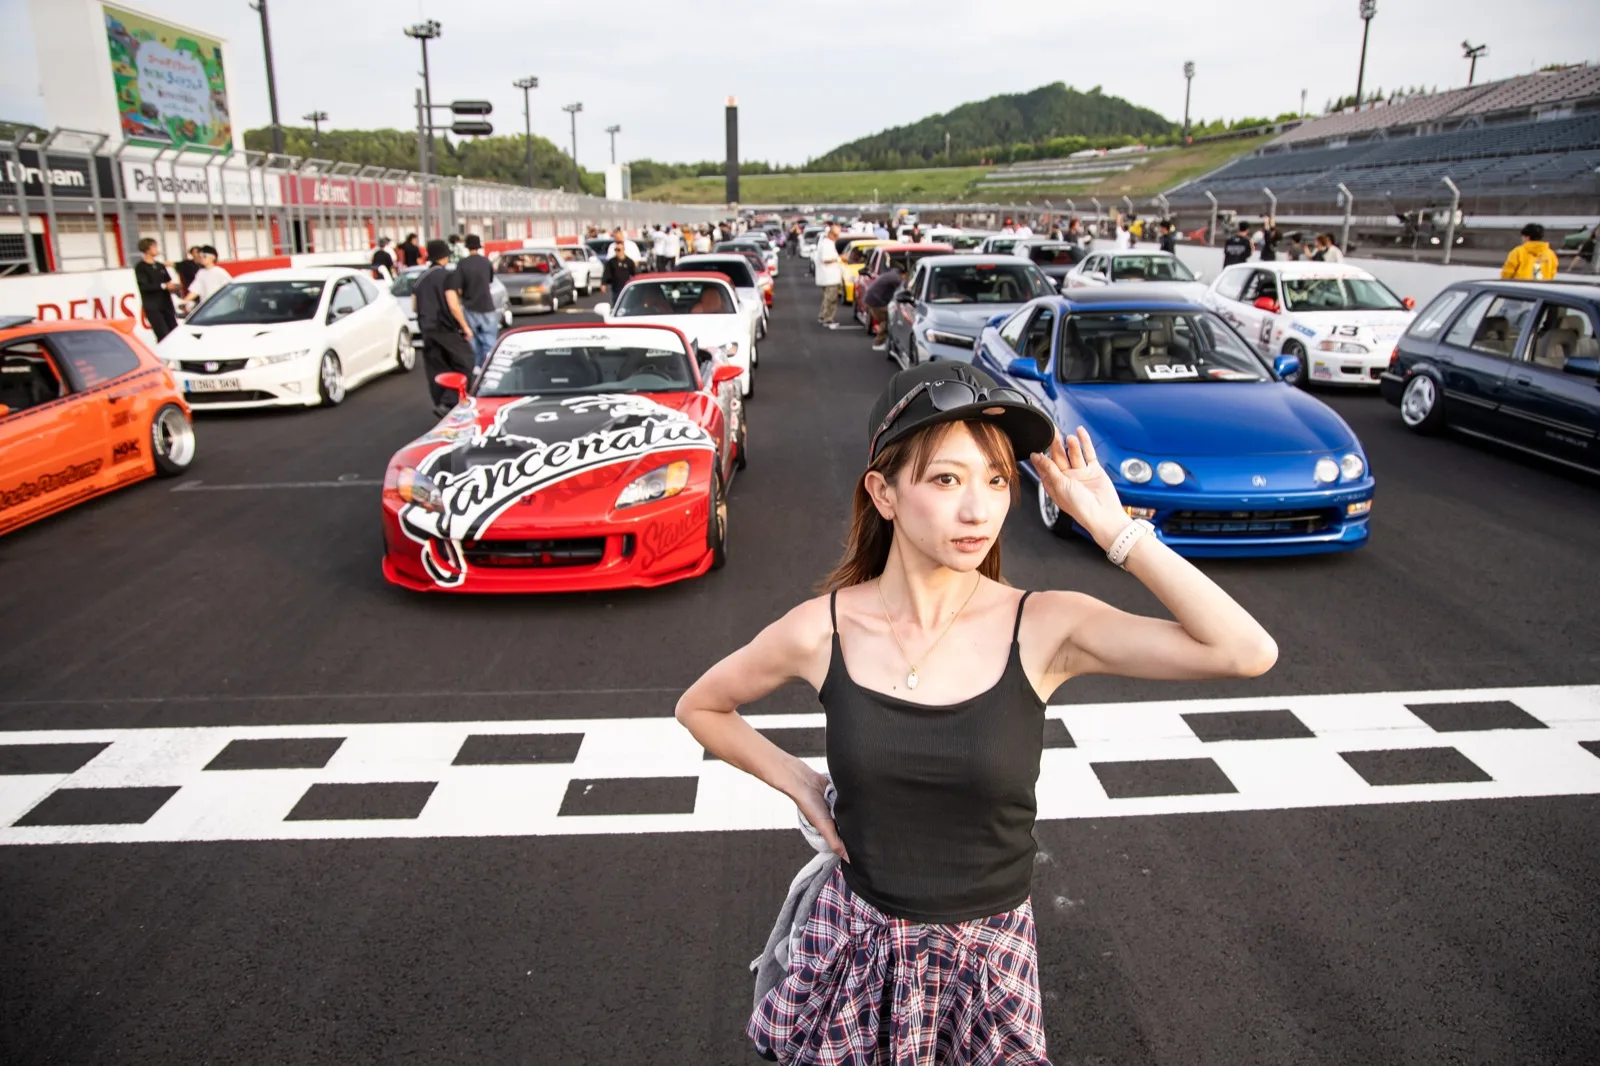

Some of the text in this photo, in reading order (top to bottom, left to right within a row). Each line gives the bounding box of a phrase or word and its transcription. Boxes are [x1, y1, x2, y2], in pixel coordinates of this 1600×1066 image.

[133, 168, 209, 194] Panasonic
[37, 292, 152, 330] DENS
[1331, 324, 1359, 337] 13
